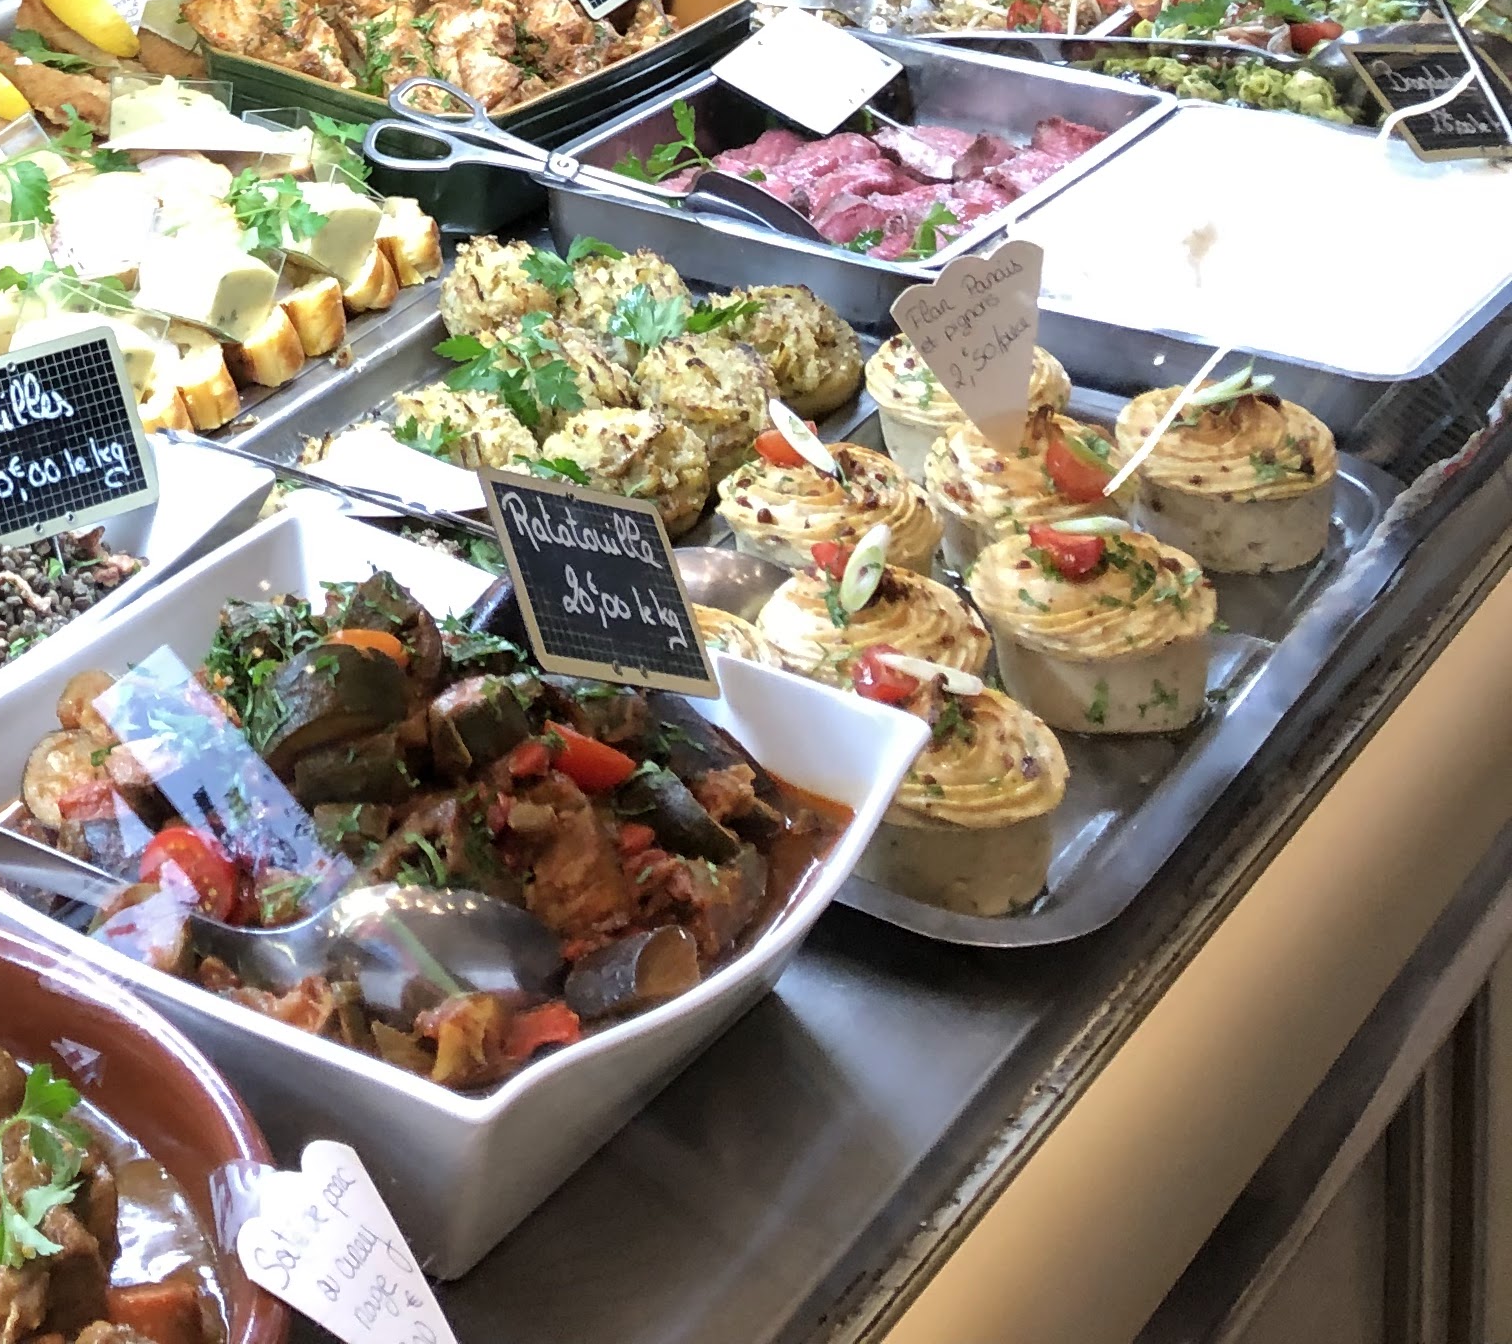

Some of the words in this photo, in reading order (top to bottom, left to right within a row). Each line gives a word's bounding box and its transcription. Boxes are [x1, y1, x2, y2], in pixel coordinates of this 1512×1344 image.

[906, 299, 955, 329] Flan
[921, 336, 938, 354] et
[944, 294, 1000, 342] pignons
[64, 448, 91, 478] le
[89, 437, 130, 488] kg
[502, 491, 663, 569] Ratatouille
[631, 586, 657, 626] le
[648, 588, 688, 650] kg
[323, 1167, 356, 1217] porc
[317, 1274, 340, 1302] au
[334, 1224, 413, 1274] curry
[354, 1274, 400, 1331] rouge
